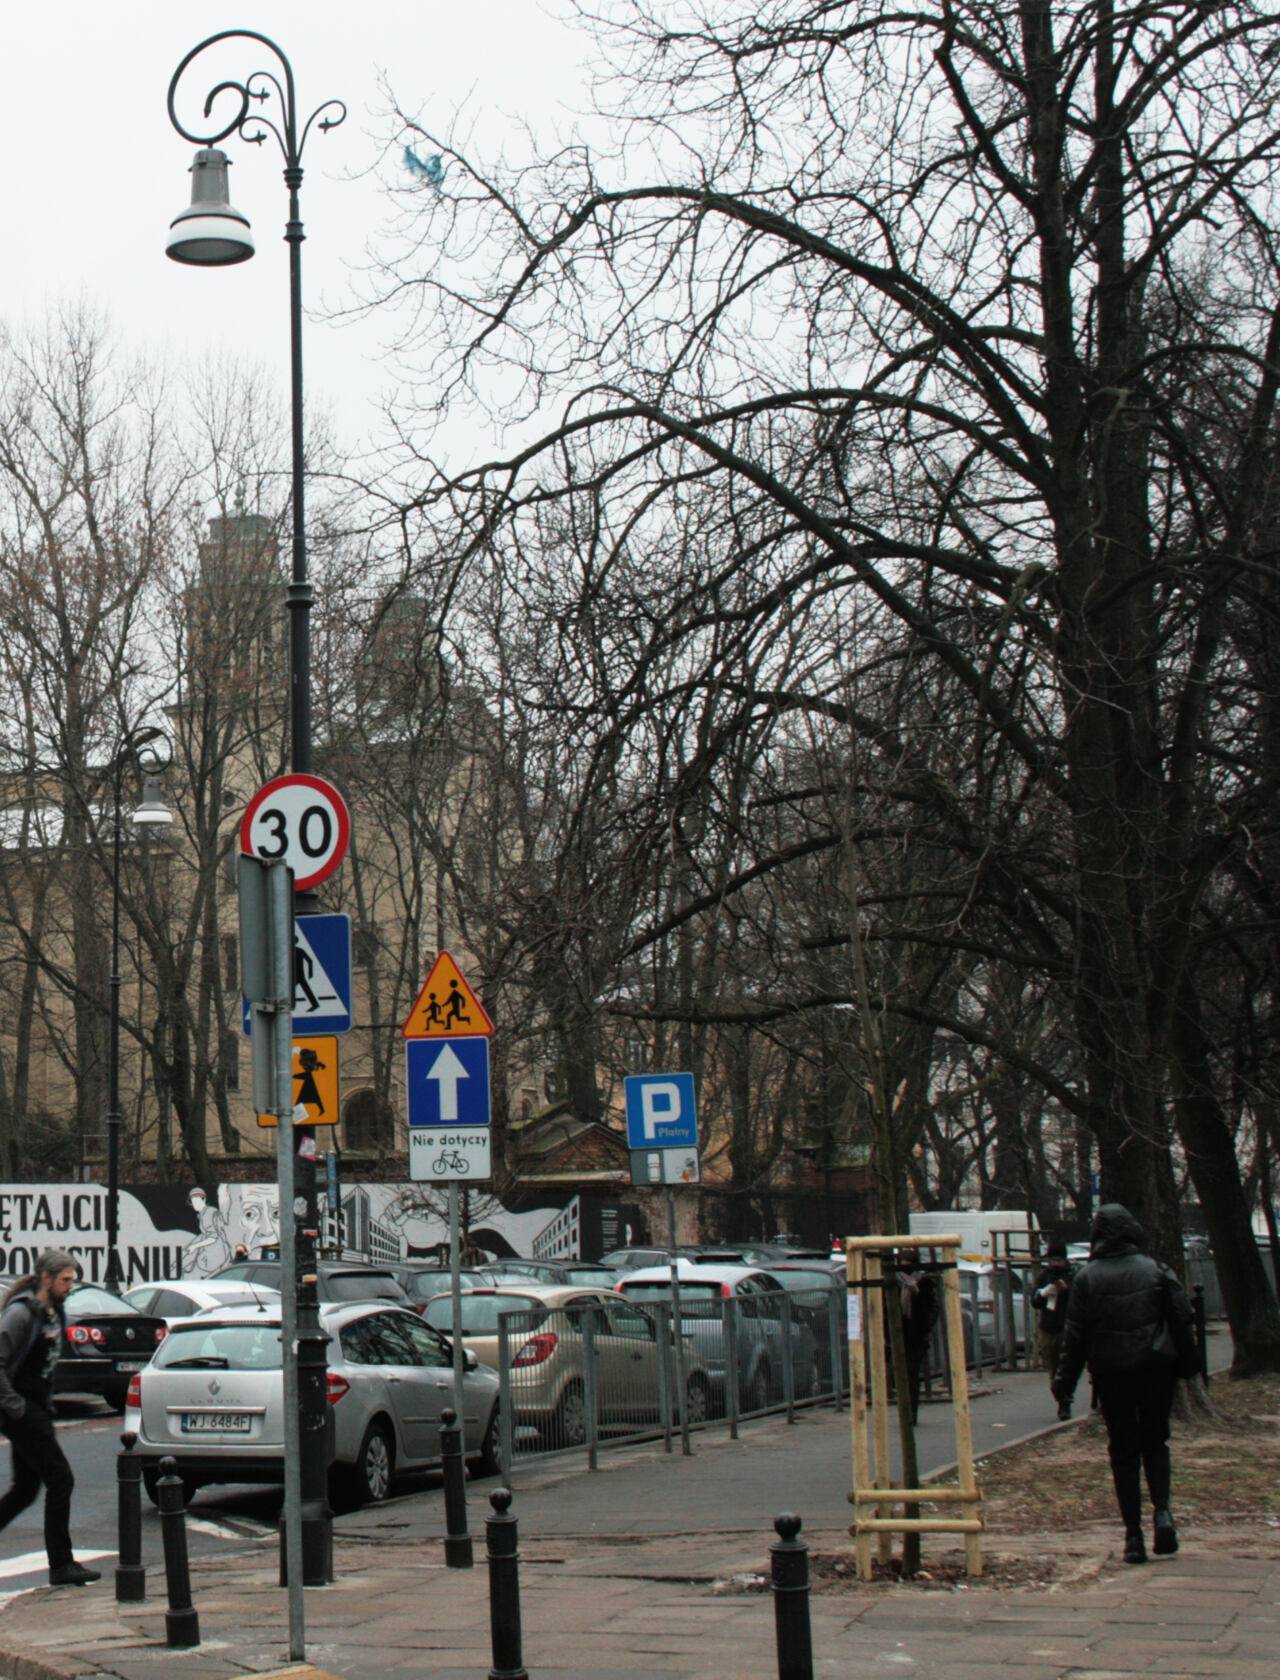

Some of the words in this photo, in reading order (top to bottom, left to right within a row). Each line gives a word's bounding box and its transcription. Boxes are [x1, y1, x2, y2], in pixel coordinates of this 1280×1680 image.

[258, 805, 331, 858] 30
[641, 1083, 681, 1139] P
[413, 1134, 434, 1146] Nie
[440, 1134, 487, 1148] dotyczy
[190, 1415, 205, 1428] WJ
[210, 1415, 247, 1428] 6484F
